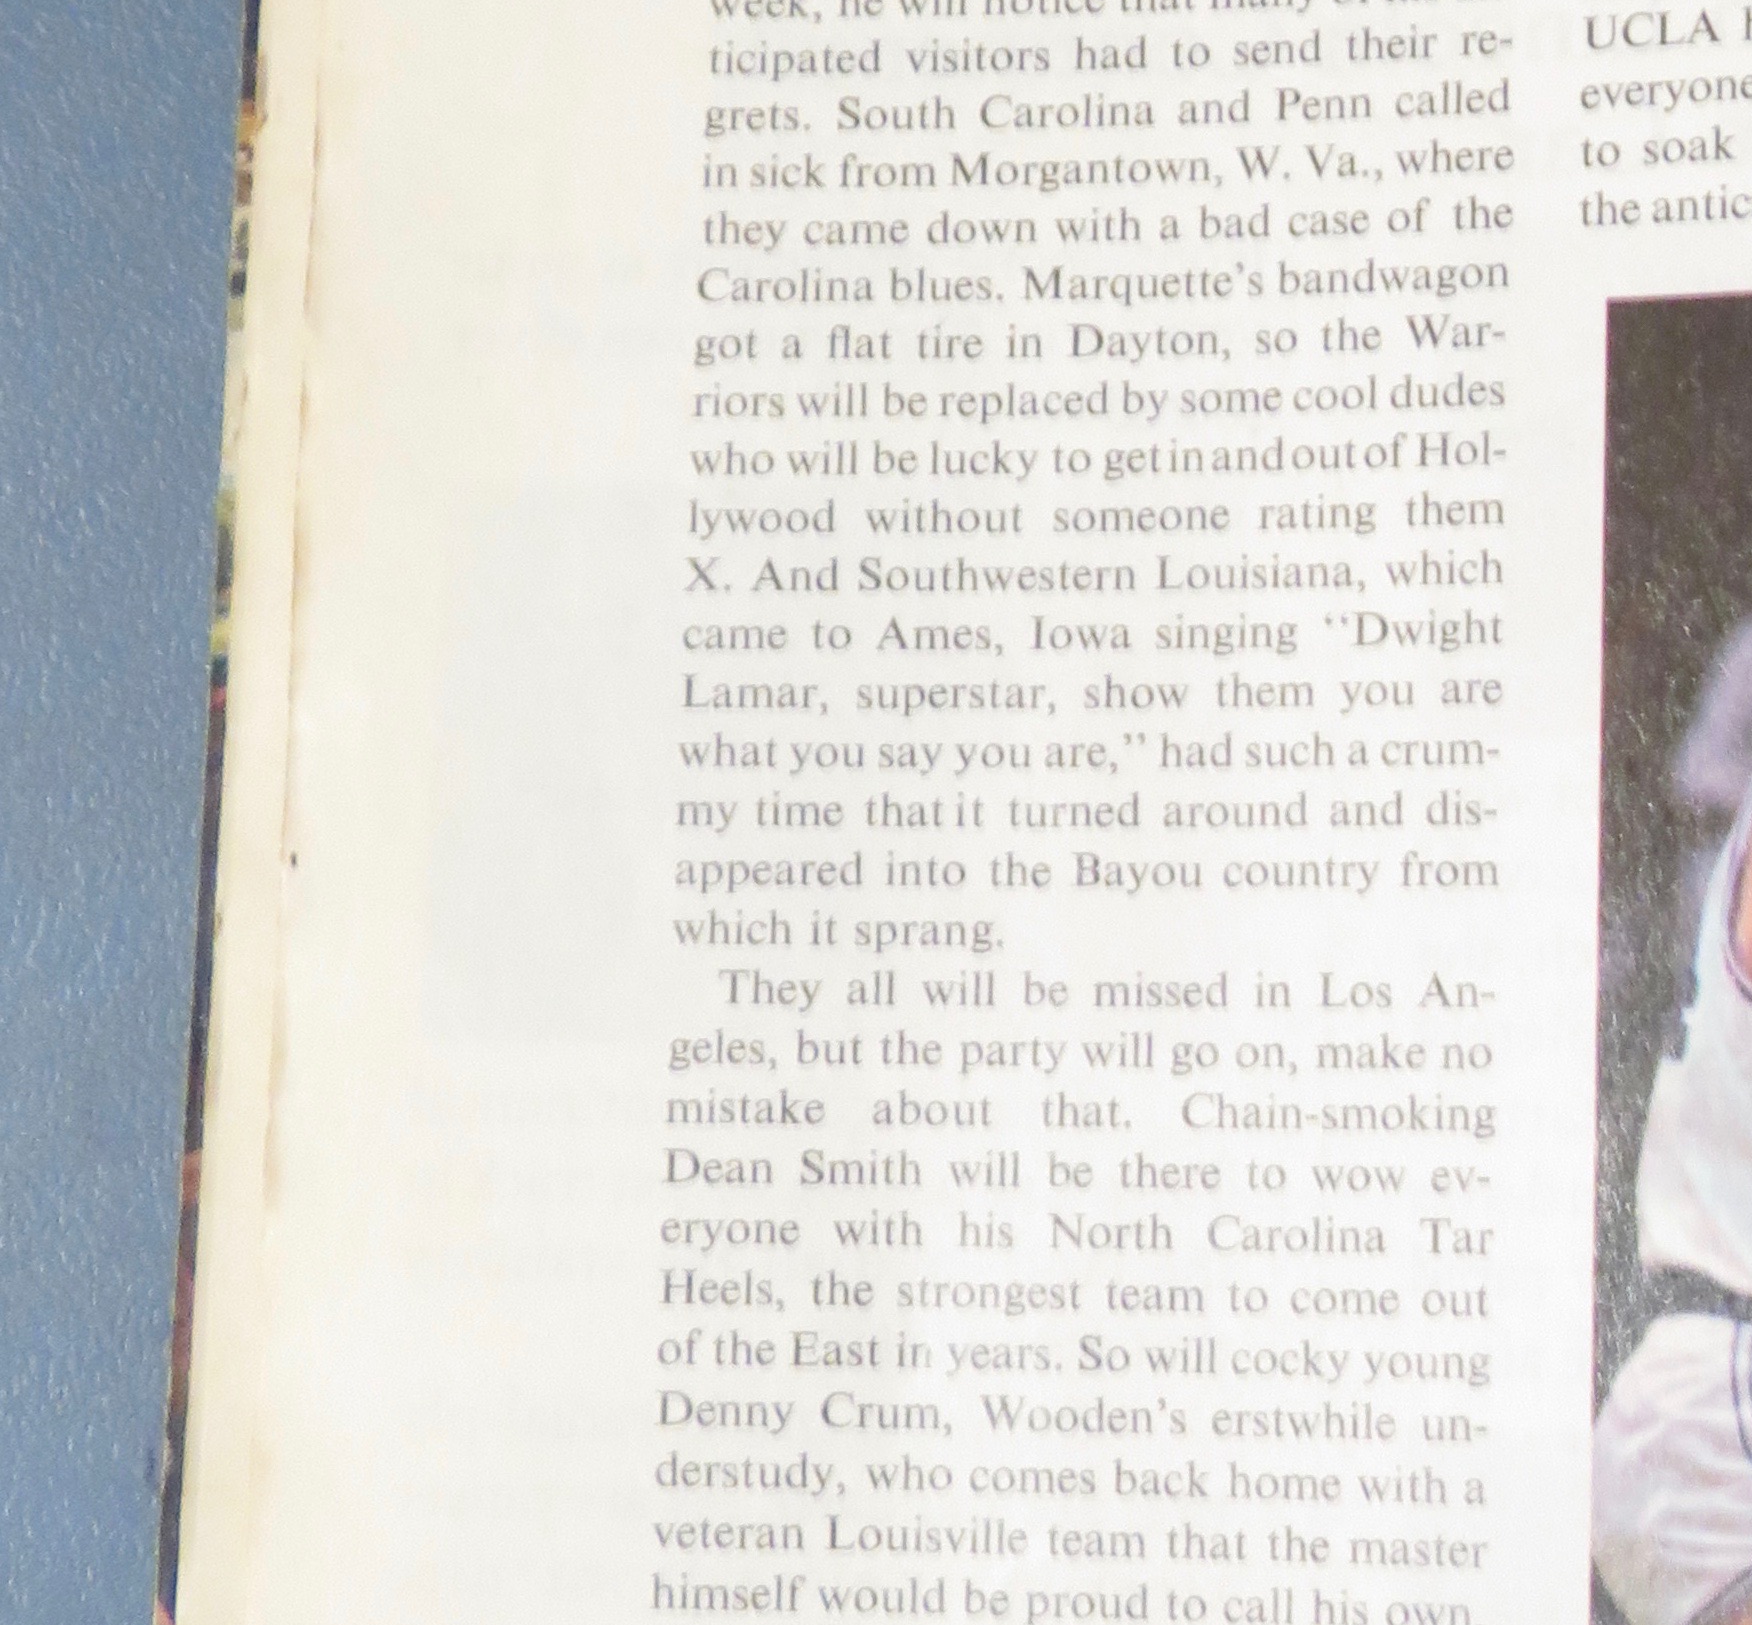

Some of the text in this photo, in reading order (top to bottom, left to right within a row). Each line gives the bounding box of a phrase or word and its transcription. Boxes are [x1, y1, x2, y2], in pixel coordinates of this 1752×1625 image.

[704, 78, 1510, 138] grets. South Carolina and Penn called
[686, 549, 1503, 592] X. And Southwestern Louisiana, which
[676, 851, 1498, 895] appeared into the Bayou country from
[667, 1089, 1495, 1139] mistake about that. Chain-smoking
